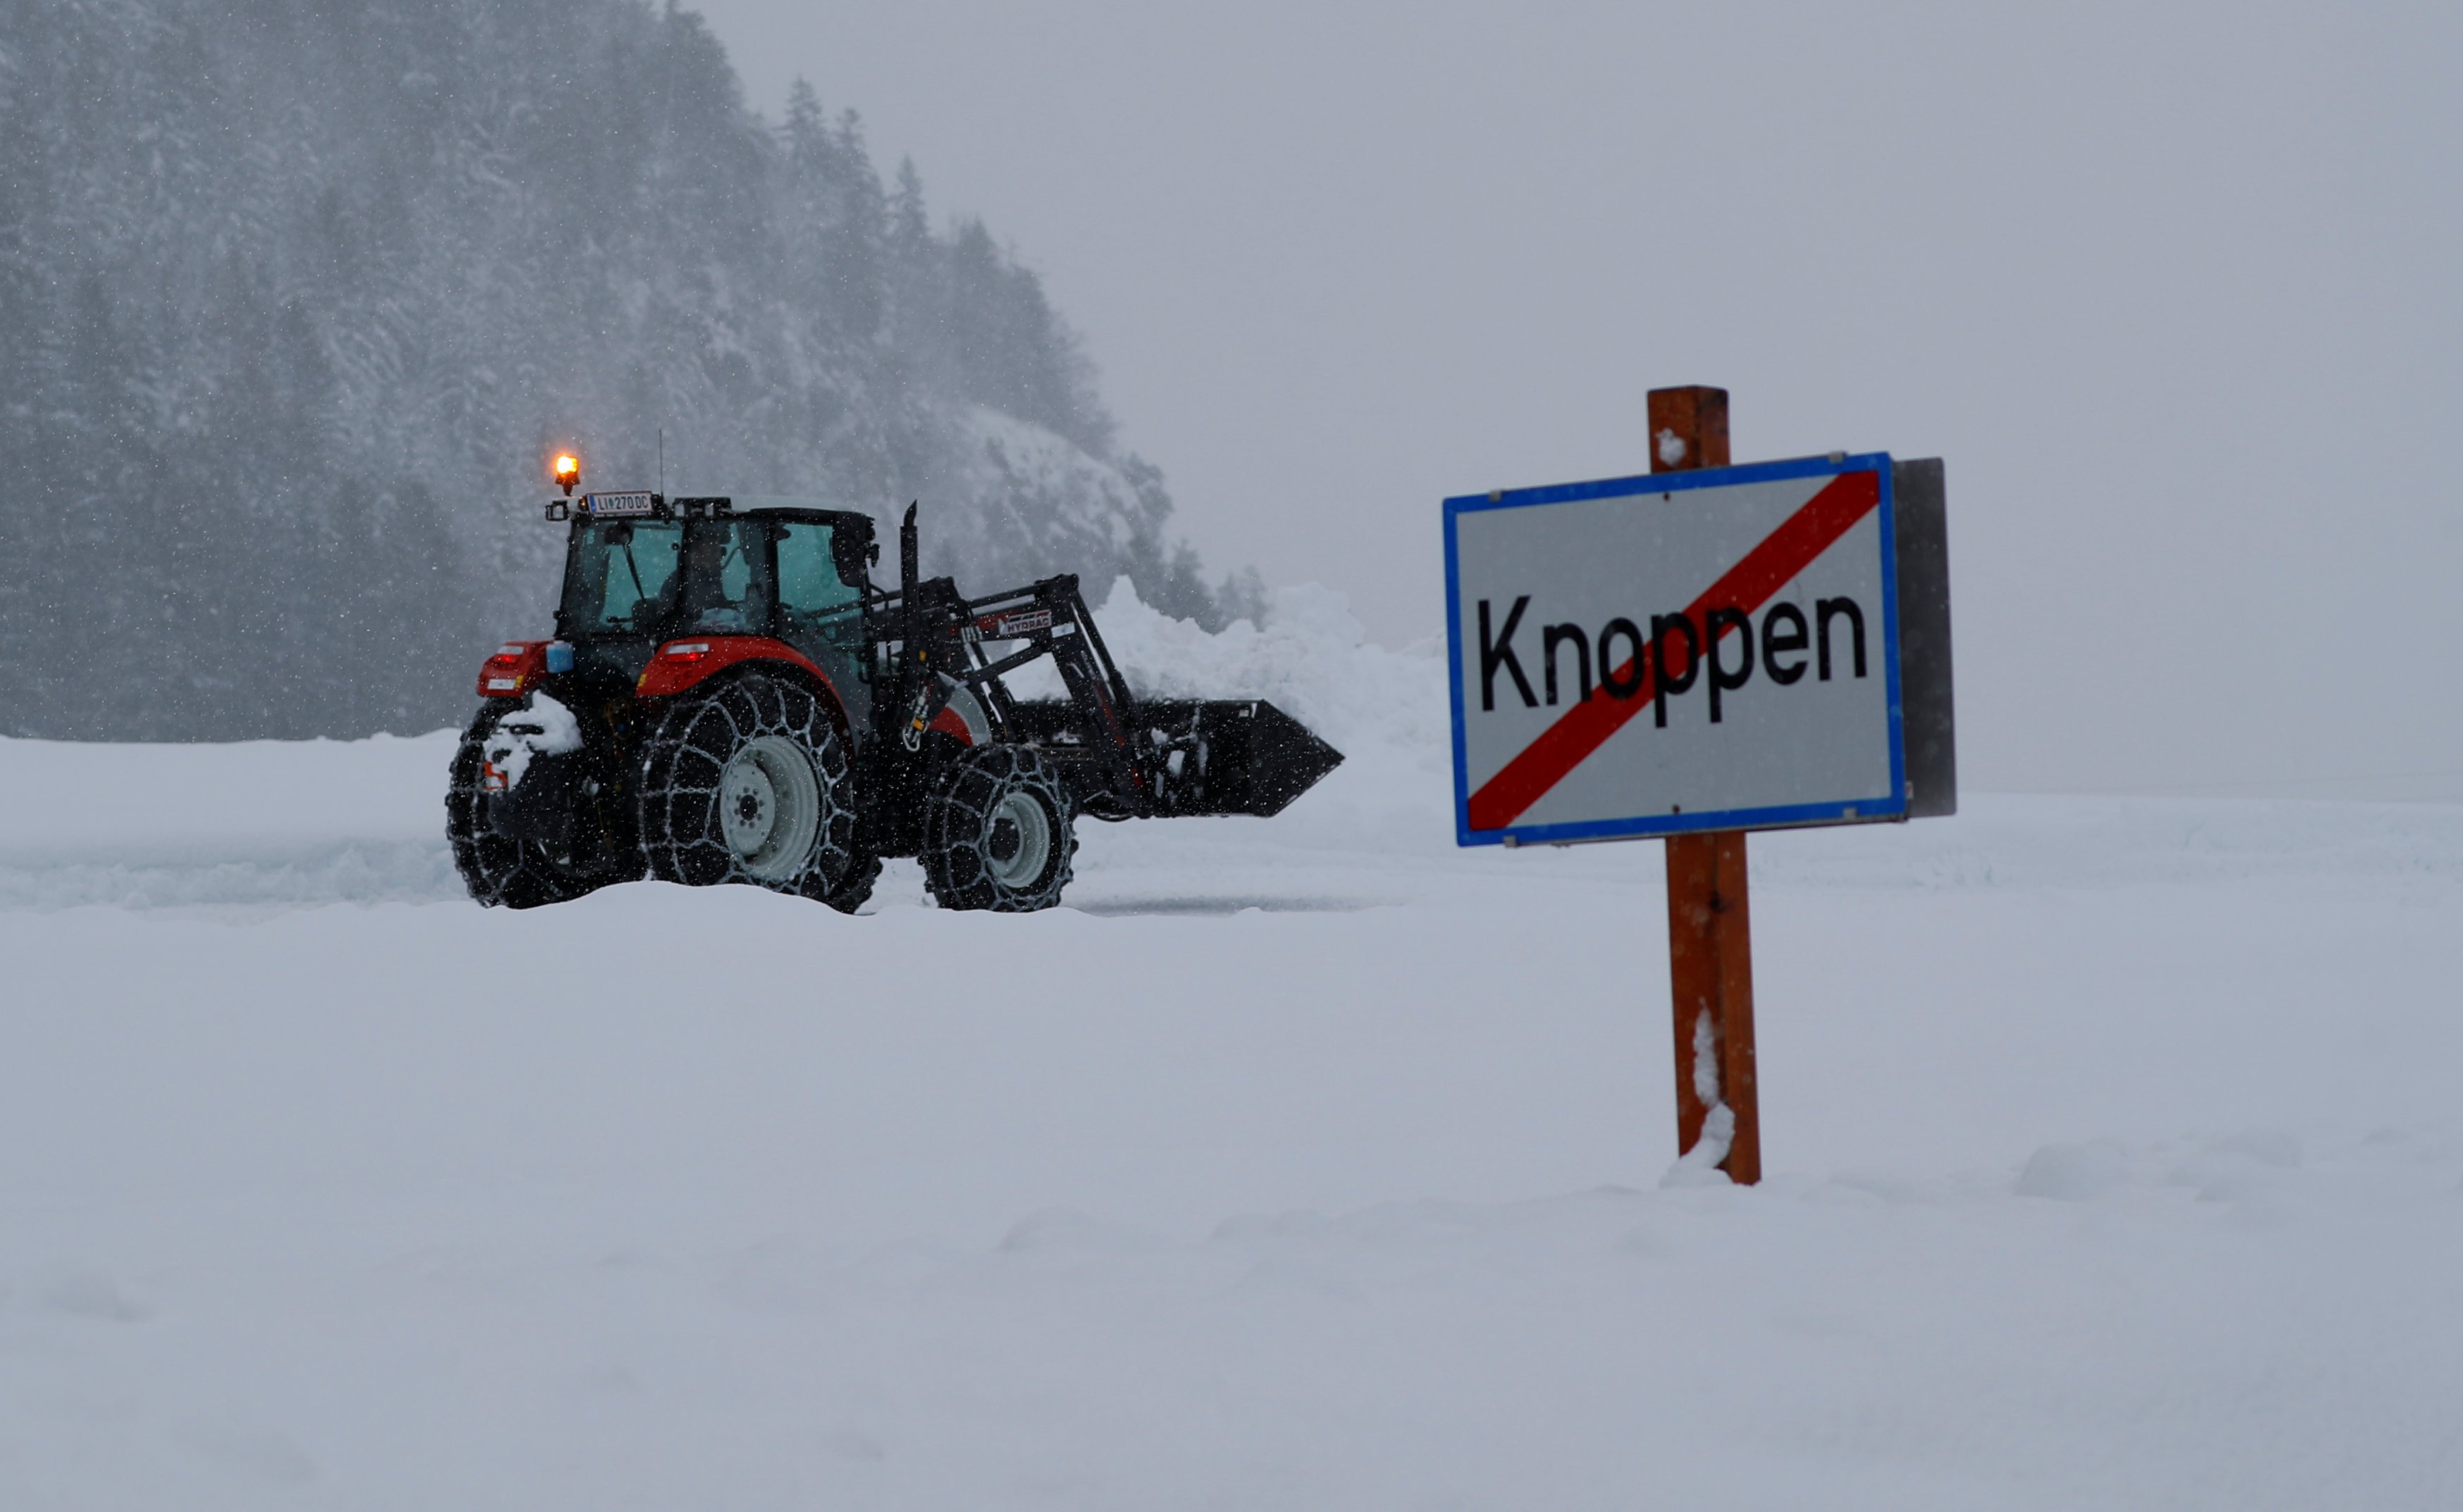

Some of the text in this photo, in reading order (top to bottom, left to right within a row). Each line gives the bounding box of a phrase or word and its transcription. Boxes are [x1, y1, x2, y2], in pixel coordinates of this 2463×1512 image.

[598, 495, 649, 510] LI 270 DC
[1478, 595, 1866, 728] Knoppen
